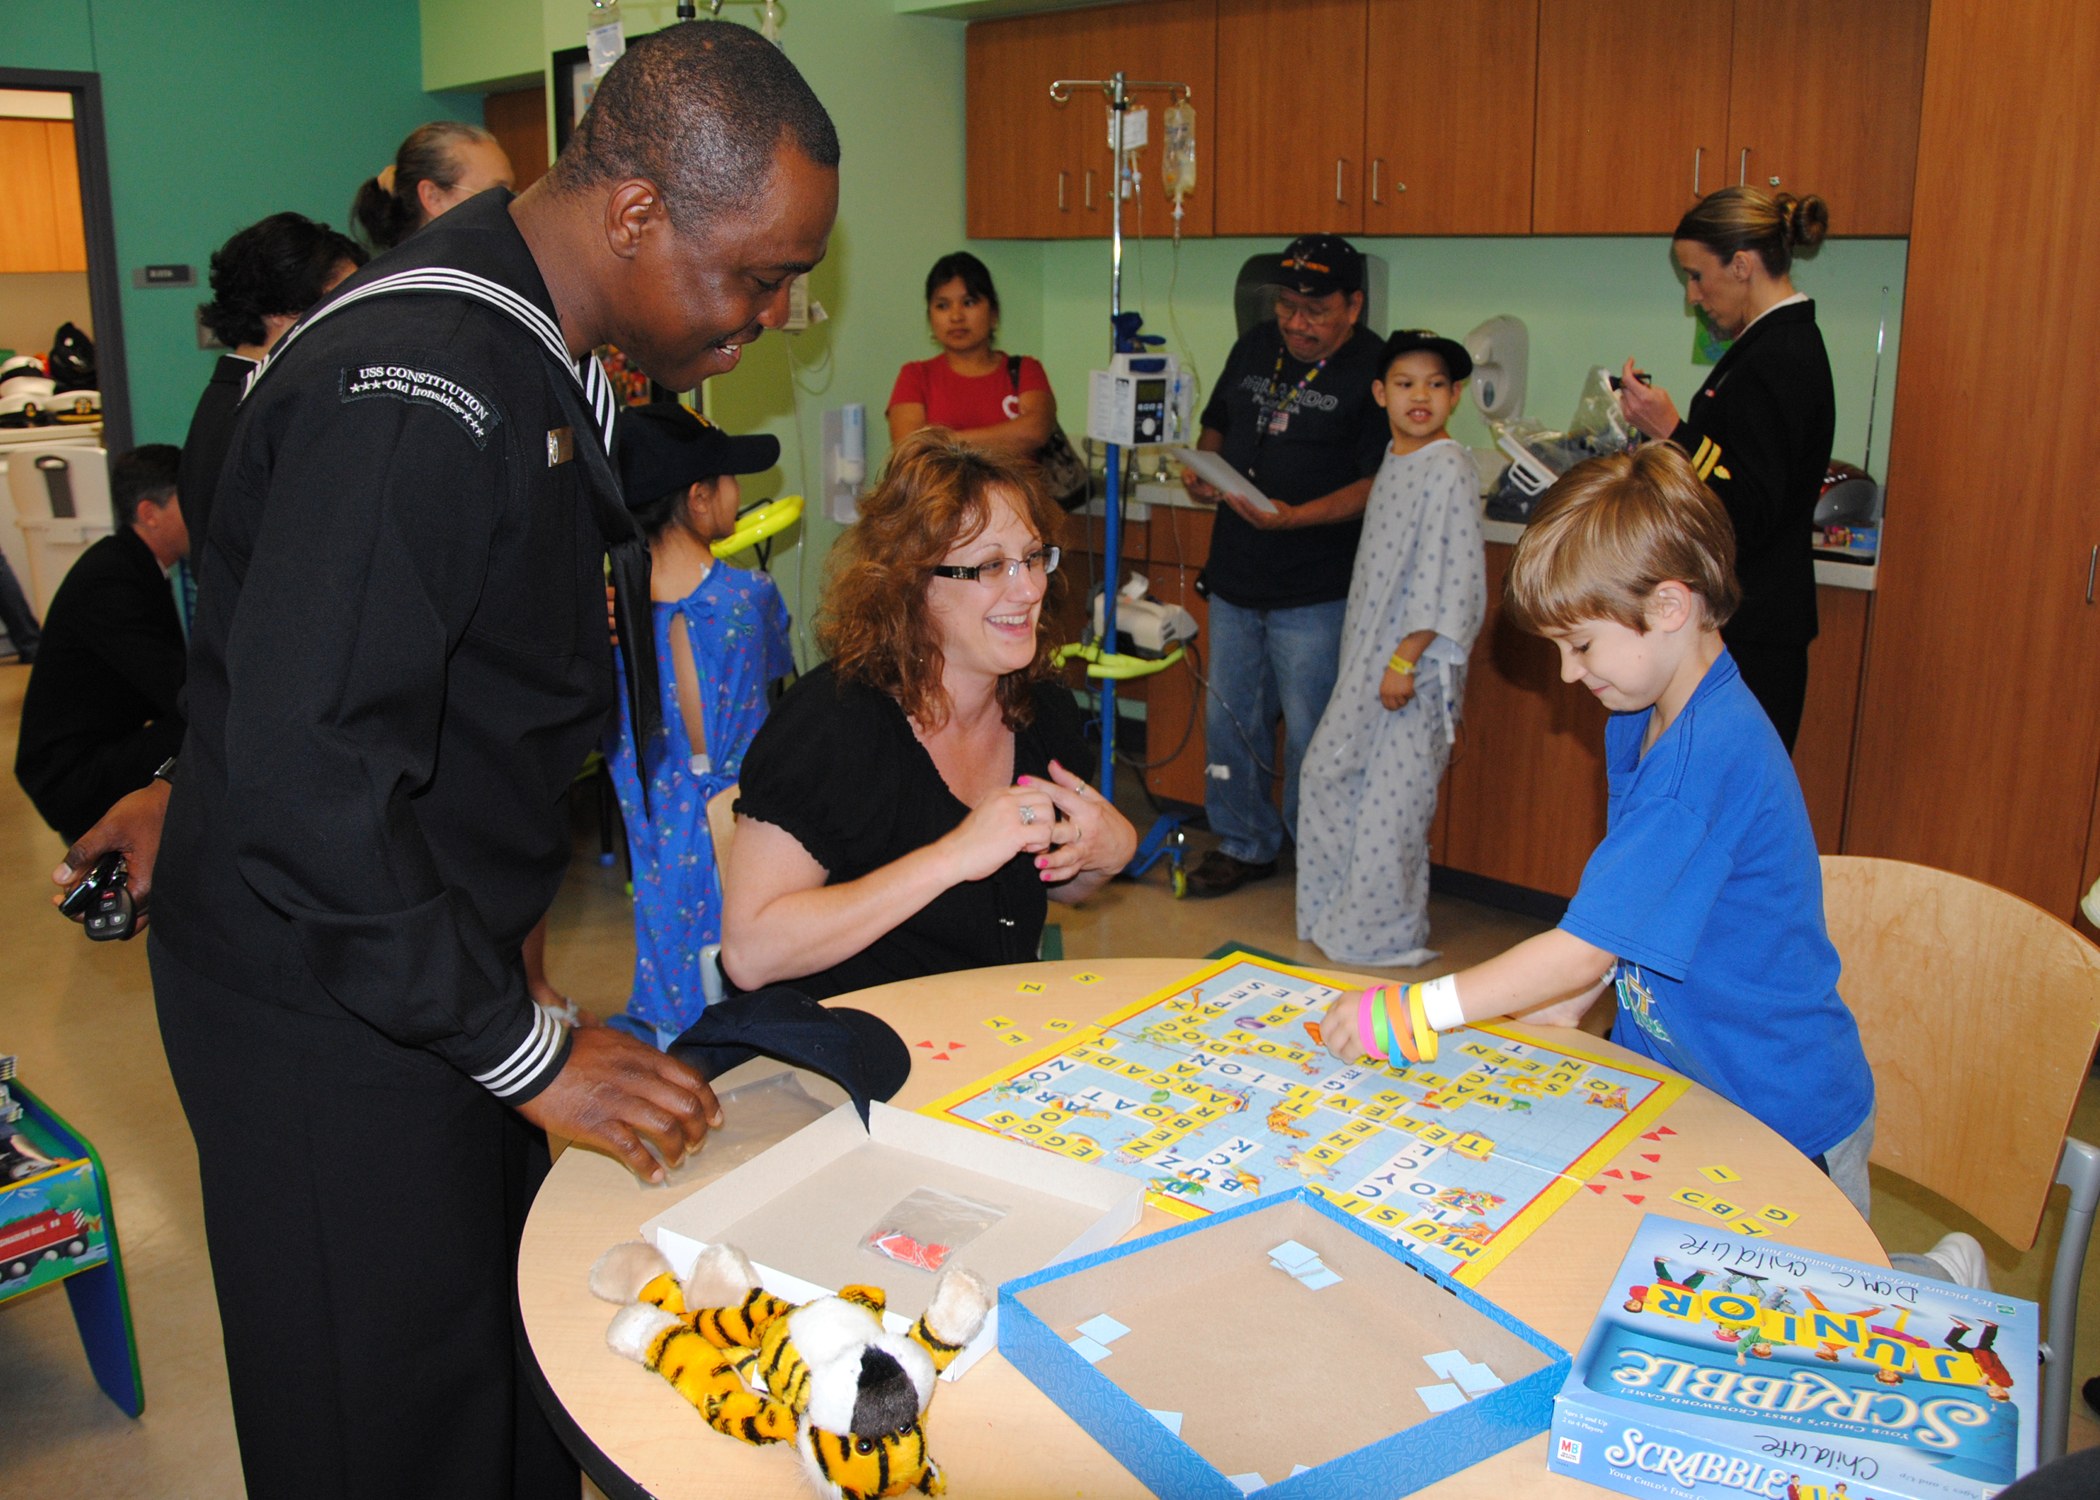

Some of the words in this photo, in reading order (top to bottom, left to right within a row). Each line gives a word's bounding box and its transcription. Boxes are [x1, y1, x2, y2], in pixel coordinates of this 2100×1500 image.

[360, 366, 385, 380] USS
[386, 366, 489, 420] CONSTITUTION
[1659, 1287, 1959, 1379] JUNIOR
[1612, 1350, 1990, 1449] SCRABBLE
[1561, 1440, 1579, 1454] MB
[1604, 1428, 1790, 1500] SCRABBLE
